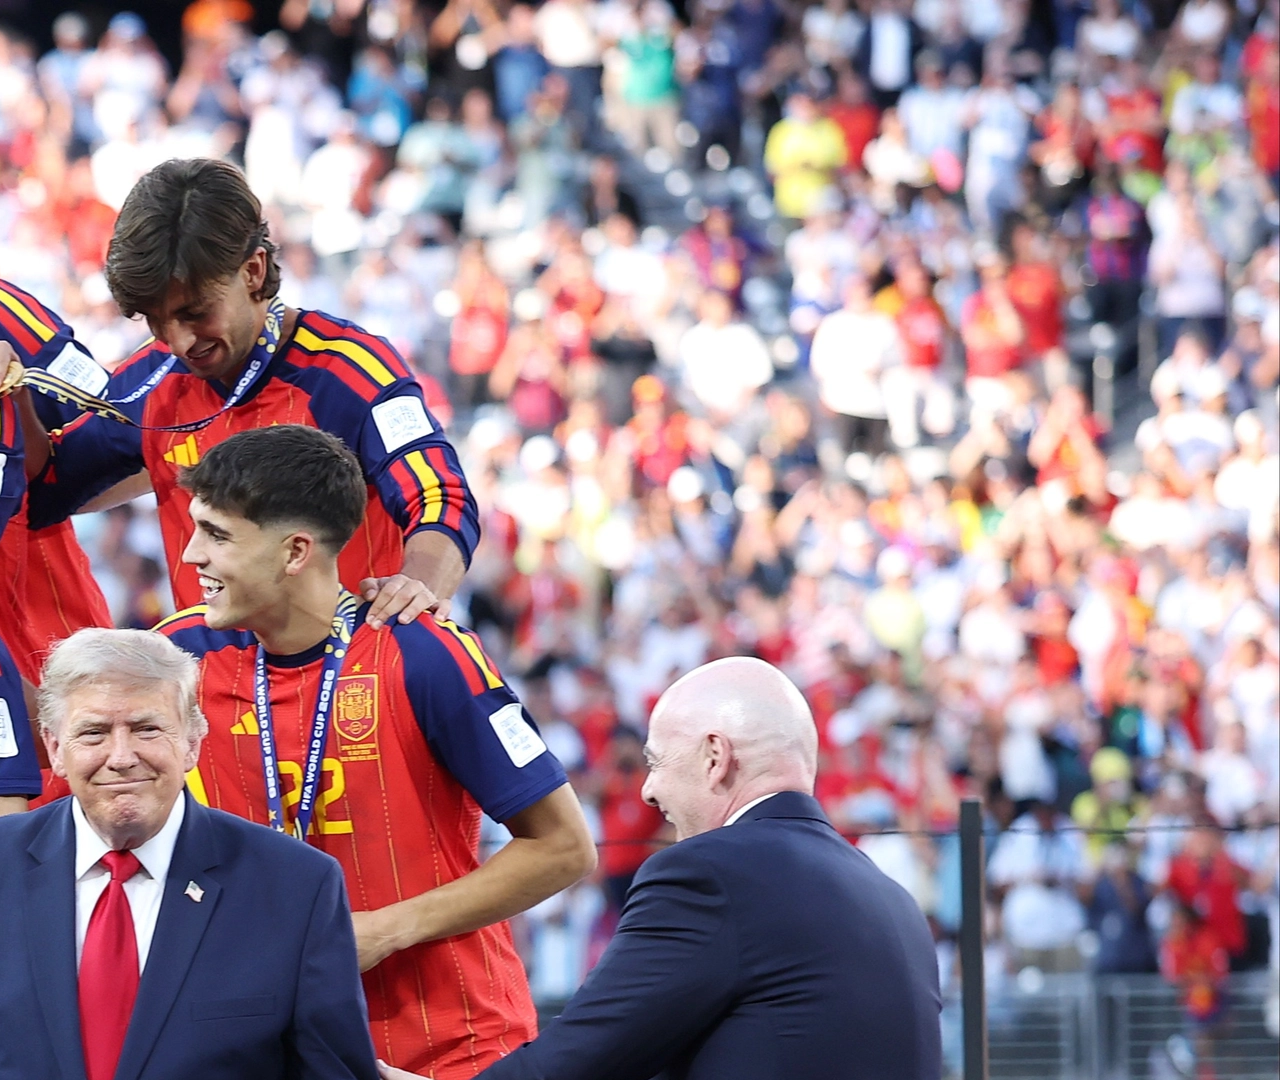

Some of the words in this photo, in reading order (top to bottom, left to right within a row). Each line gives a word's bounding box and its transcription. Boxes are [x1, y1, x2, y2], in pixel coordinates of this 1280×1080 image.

[234, 360, 262, 395] 2026
[257, 685, 269, 729] WORLD
[318, 669, 336, 713] 2026
[261, 730, 272, 755] CUP
[313, 713, 326, 739] CUP
[264, 756, 277, 799] 2026
[306, 739, 322, 783] WORLD
[301, 784, 314, 811] FIFA
